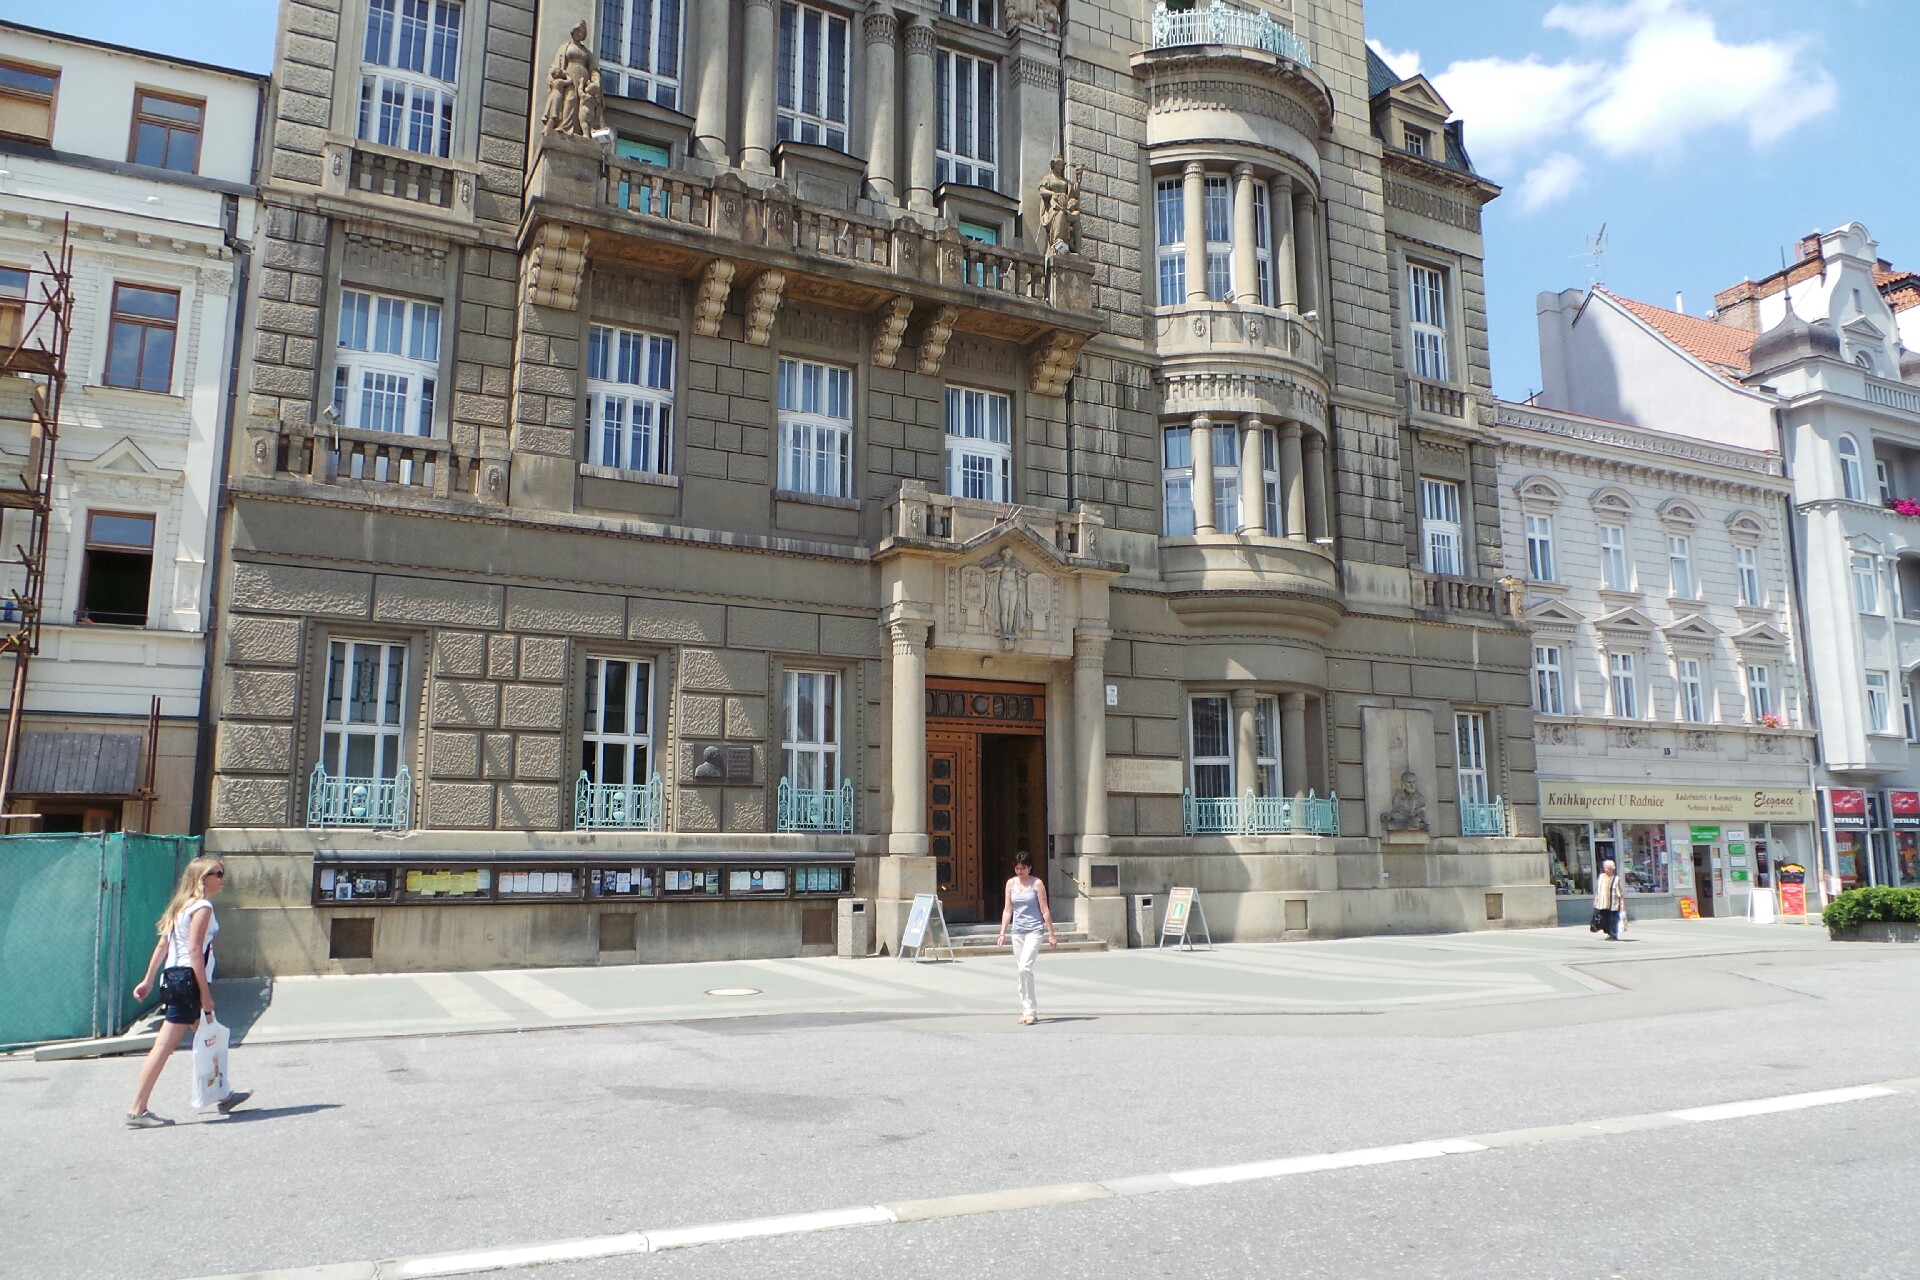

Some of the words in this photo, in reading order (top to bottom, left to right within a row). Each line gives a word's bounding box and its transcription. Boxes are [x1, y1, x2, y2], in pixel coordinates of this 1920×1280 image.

[1663, 747, 1671, 756] 15
[1548, 792, 1616, 809] Knihkupectví
[1619, 794, 1627, 806] U
[1629, 795, 1665, 807] Radnice
[1753, 791, 1794, 809] Elegance
